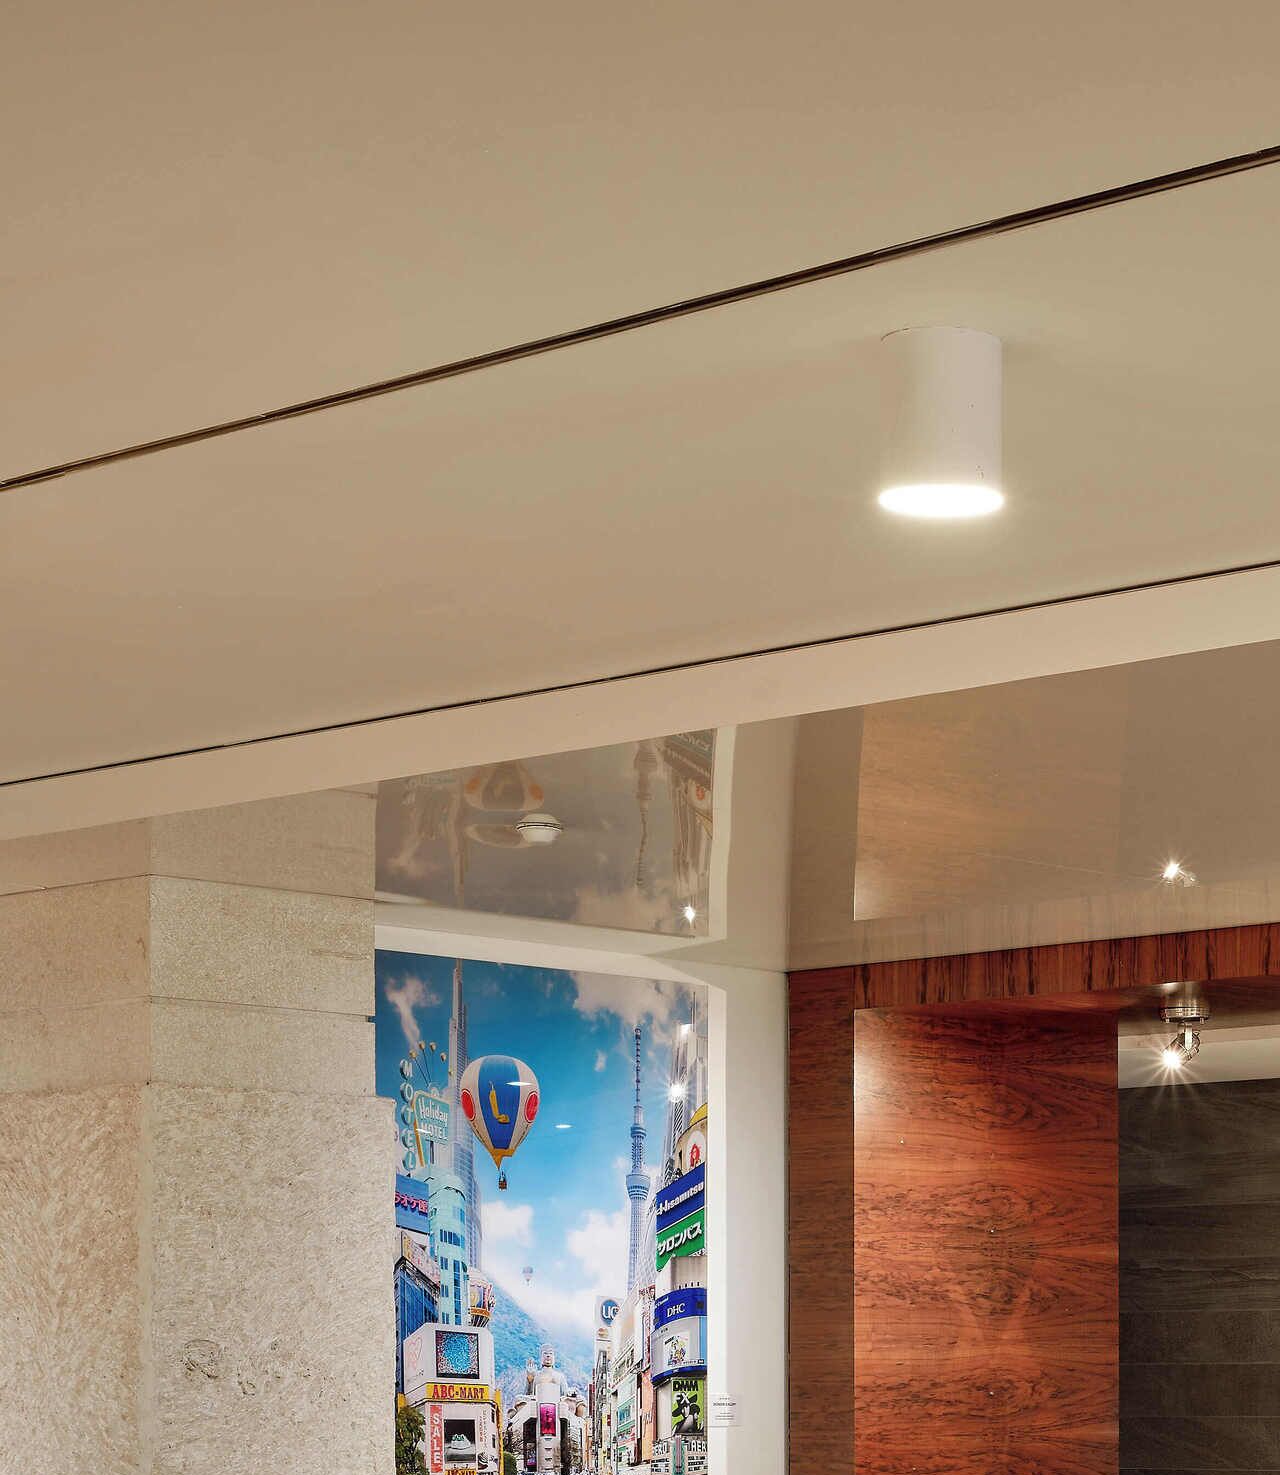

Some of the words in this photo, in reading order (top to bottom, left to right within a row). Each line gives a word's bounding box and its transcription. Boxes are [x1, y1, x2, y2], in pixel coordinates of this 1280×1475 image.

[402, 1059, 416, 1169] MOTEL
[418, 1097, 448, 1121] Holiday
[420, 1121, 448, 1140] MOTEL
[656, 1182, 704, 1215] Hisamitsu
[657, 1222, 702, 1255] サロンパス
[667, 1303, 686, 1317] DHC
[432, 1384, 485, 1400] ABC-MART
[672, 1380, 699, 1392] DMM
